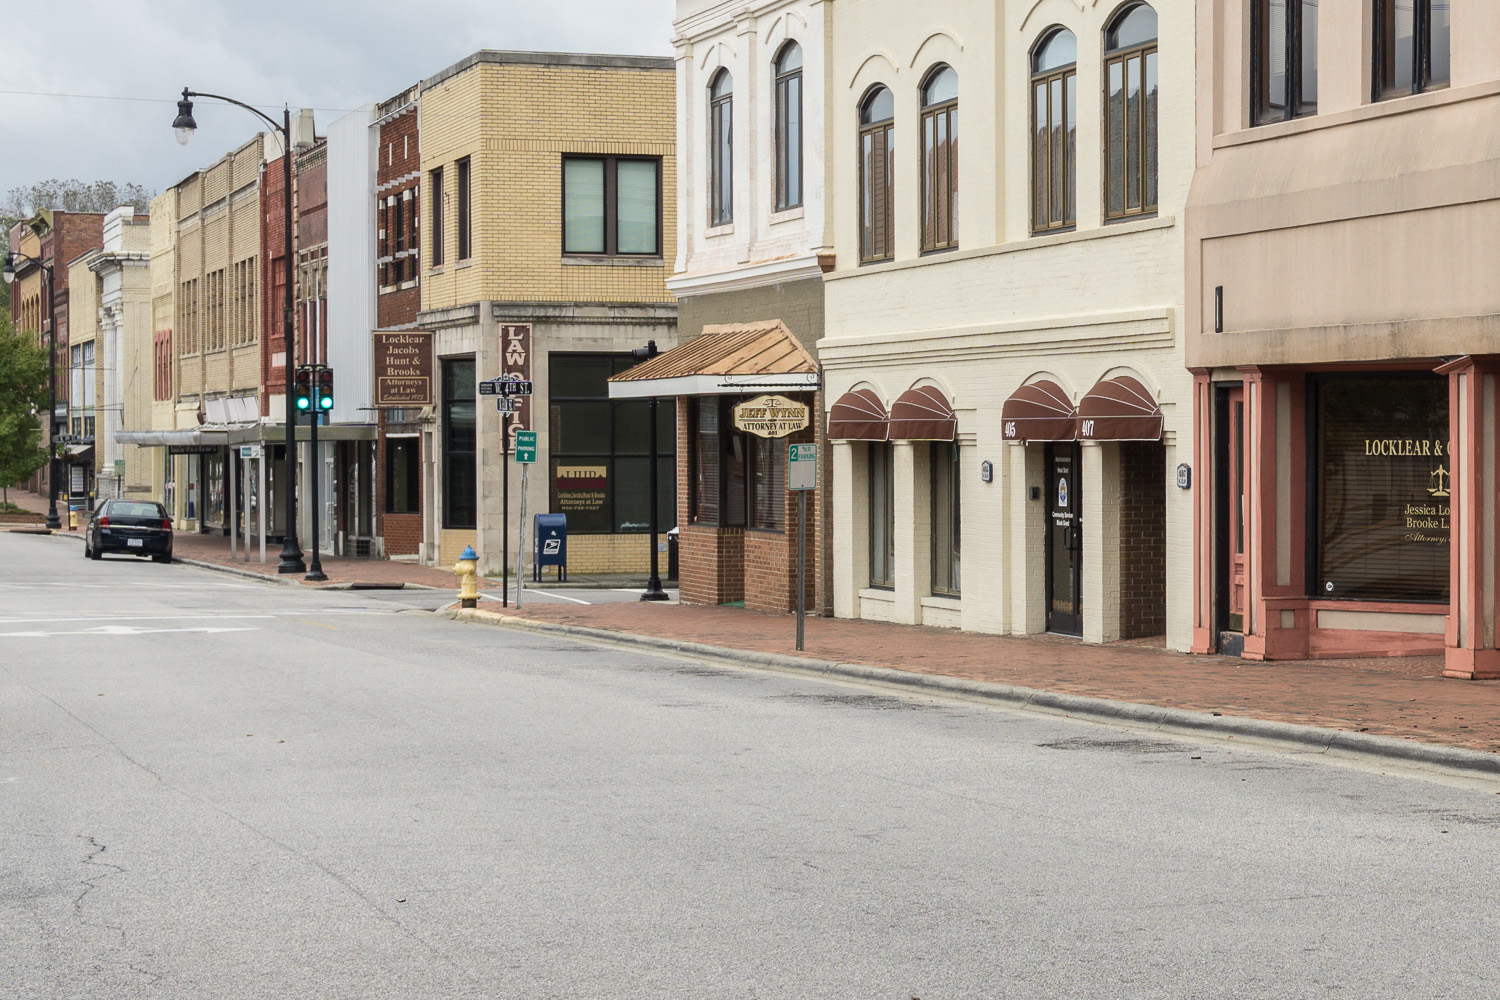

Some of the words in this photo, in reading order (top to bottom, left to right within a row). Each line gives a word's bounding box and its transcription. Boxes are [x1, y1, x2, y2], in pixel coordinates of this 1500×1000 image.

[382, 335, 424, 343] Locklear
[387, 346, 419, 354] Jacobs
[386, 356, 410, 365] Hunt
[412, 356, 421, 365] &
[387, 367, 420, 376] Brooks
[386, 379, 422, 387] Attorneys
[504, 382, 517, 394] 4TH
[739, 407, 767, 418] JEFF
[768, 407, 805, 418] WYNN
[743, 422, 777, 430] ATTORNEY
[778, 422, 787, 430] AT
[788, 422, 802, 430] LAW
[1005, 421, 1016, 437] 405
[1082, 420, 1094, 436] 407
[1365, 439, 1431, 456] LOCKLEAR
[1434, 439, 1443, 456] &
[791, 448, 797, 459] 2
[1404, 504, 1436, 515] Jessica
[1406, 517, 1439, 528] Brooke
[1441, 518, 1450, 529] L.
[1404, 532, 1447, 546] Attorneys
